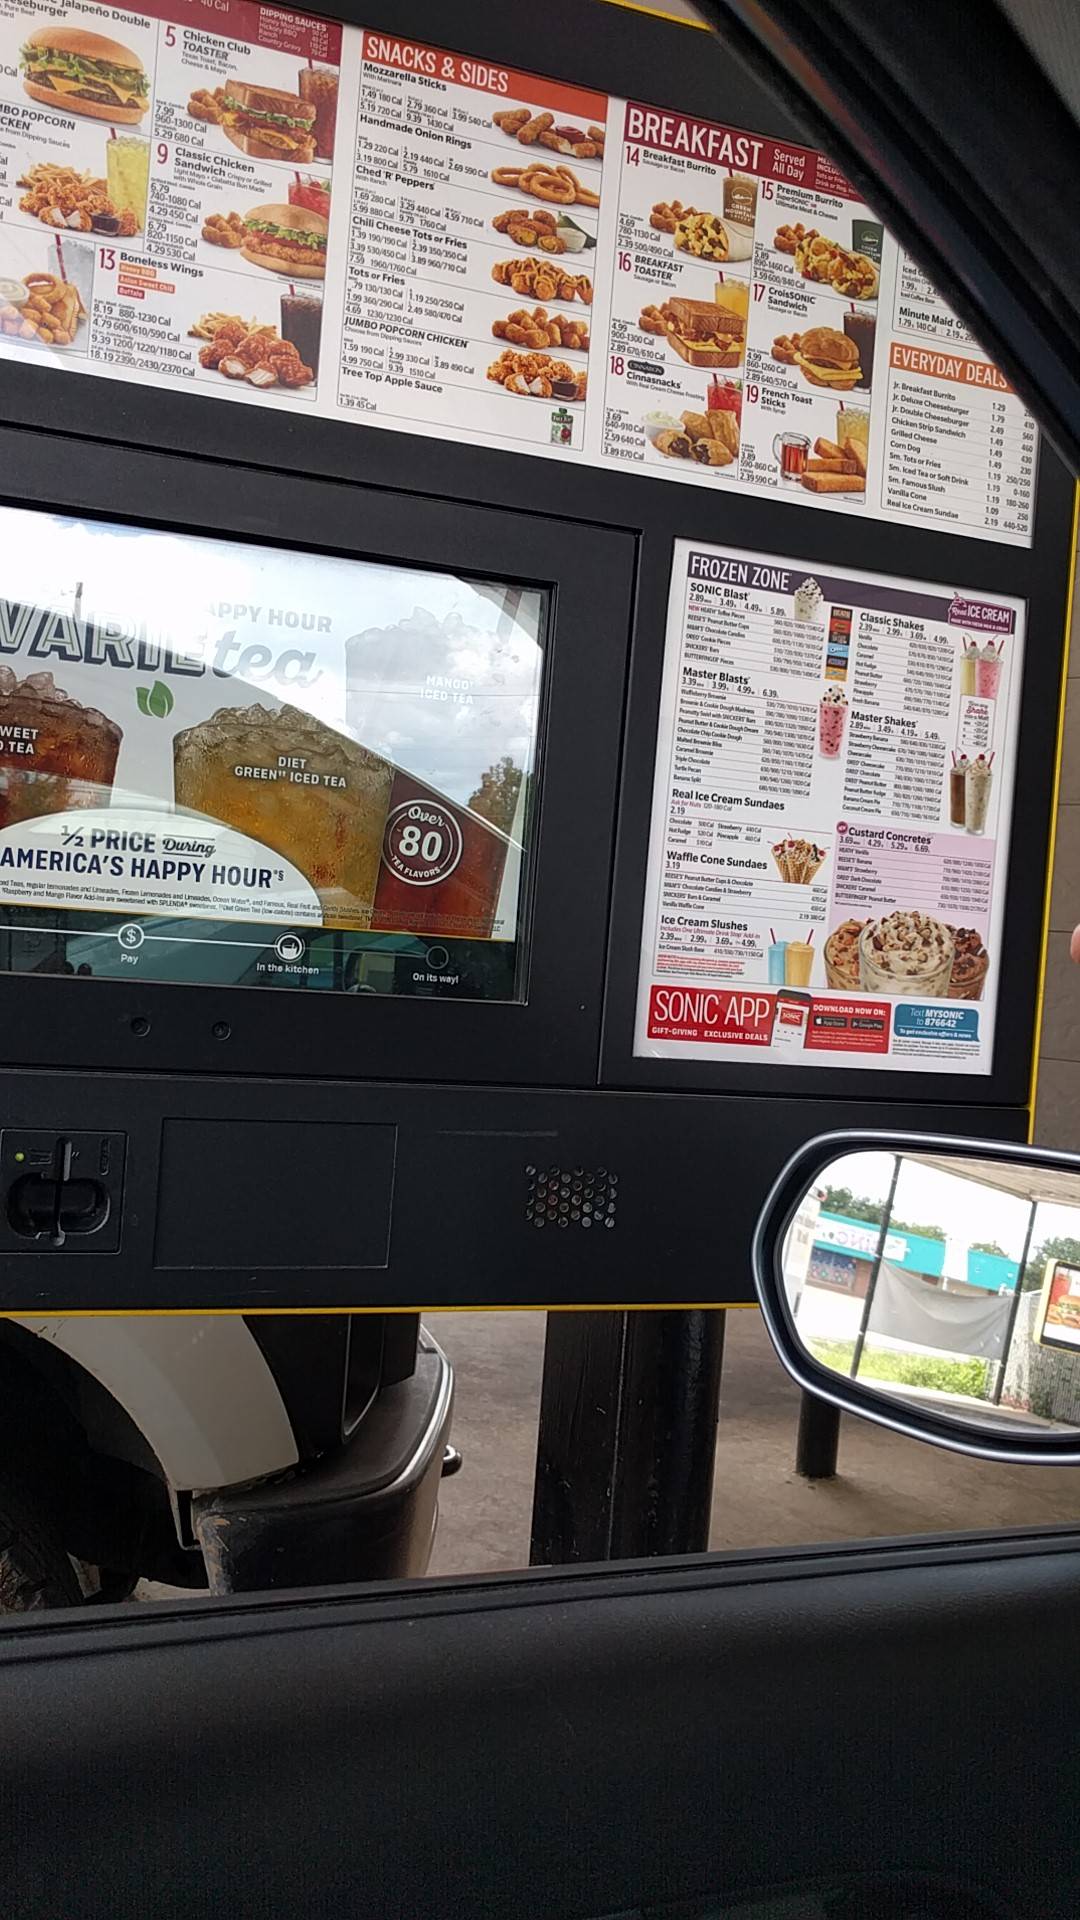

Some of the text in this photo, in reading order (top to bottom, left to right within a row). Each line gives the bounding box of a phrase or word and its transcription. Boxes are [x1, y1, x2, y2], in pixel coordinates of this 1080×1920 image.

[112, 11, 150, 28] Double
[260, 8, 327, 32] DIPPING SAUCES
[165, 25, 176, 47] 5
[183, 30, 251, 55] Chicken Club
[183, 41, 229, 60] TOASTER
[367, 36, 509, 93] SNACKS & SIDES
[363, 63, 447, 91] Mozzarella Sticks
[21, 109, 75, 130] POPCORN
[360, 115, 472, 150] Handmade Onion Rings
[628, 109, 764, 171] BREAKFAST
[157, 143, 169, 164] 9
[175, 148, 255, 174] Classic Chicken
[625, 145, 639, 167] 14
[643, 150, 717, 176] Breakfast Burrito
[773, 149, 806, 167] Served
[174, 157, 226, 177] Sandwich
[772, 161, 805, 182] All Day
[356, 165, 381, 179] Ched
[395, 174, 435, 190] Peppers
[762, 180, 774, 200] 15
[777, 185, 843, 209] Premium Burrito
[352, 216, 468, 249] Chili Cheese Tots or Fries
[99, 247, 116, 271] 13
[120, 252, 168, 271] Boneless
[170, 262, 204, 278] Wings
[617, 251, 631, 273] 16
[634, 255, 684, 274] BREAKFAST
[349, 267, 406, 286] Tots or Fries
[634, 265, 673, 281] TOASTER
[752, 283, 765, 303] 17
[768, 286, 816, 305] CroisSONIC
[767, 296, 808, 313] Sandwich
[899, 307, 953, 327] Minute Maid
[92, 318, 113, 329] 4.79
[166, 331, 181, 343] Cal
[344, 316, 469, 349] JUMBO POPCORN CHICKEN
[181, 365, 195, 377] Cal
[610, 355, 624, 375] 18
[893, 347, 1008, 389] EVERYDAY DEALS
[342, 367, 443, 393] Tree Top Apple Sauce
[627, 371, 681, 390] Cinnasnacks
[745, 384, 759, 404] 19
[761, 387, 813, 406] French Toast
[901, 383, 932, 396] Breakfast
[934, 390, 956, 401] Burrito
[761, 396, 786, 409] Sticks
[891, 417, 966, 438] Chicken Strip Sandwich
[888, 488, 927, 501] Vanilla Cone
[887, 499, 901, 507] Real
[912, 504, 934, 514] Cream
[935, 508, 959, 519] Sundae
[691, 555, 789, 591] FROZEN ZONE
[690, 582, 748, 601] SONIC Blast
[268, 608, 332, 632] HOUR
[860, 613, 891, 626] Classic
[893, 617, 925, 632] Shakes
[967, 604, 1010, 623] ICE CREAM
[683, 667, 749, 685] Master Blasts
[420, 688, 473, 704] ICED TEA
[851, 711, 916, 728] Master Shakes
[8, 741, 34, 754] TEA
[278, 756, 307, 770] DIET
[289, 771, 320, 785] ICED
[323, 775, 347, 789] TEA
[672, 789, 785, 811] Real Ice Cream Sundaes
[407, 805, 446, 828] Over
[90, 828, 156, 853] PRICE
[162, 837, 217, 859] During
[398, 825, 442, 862] 80
[848, 827, 932, 845] Custard Concretes
[0, 846, 124, 876] AMERICA'S
[131, 858, 206, 883] HAPPY
[391, 854, 442, 878] TEA FLAVORS
[667, 851, 768, 870] Waffle Cone Sundaes
[661, 915, 748, 931] Ice Cream Slushes
[120, 953, 139, 964] Pay
[256, 964, 319, 975] In the kitchen
[412, 973, 459, 985] On its way!
[654, 990, 770, 1027] SONIC APP
[813, 1004, 854, 1014] DOWNLOAD
[873, 1008, 886, 1017] ON:
[910, 1008, 964, 1019] Text MYSONIC
[924, 1018, 957, 1028] 876642
[652, 1027, 768, 1041] GIFT-GIVING EXCLUSIVE DEALS
